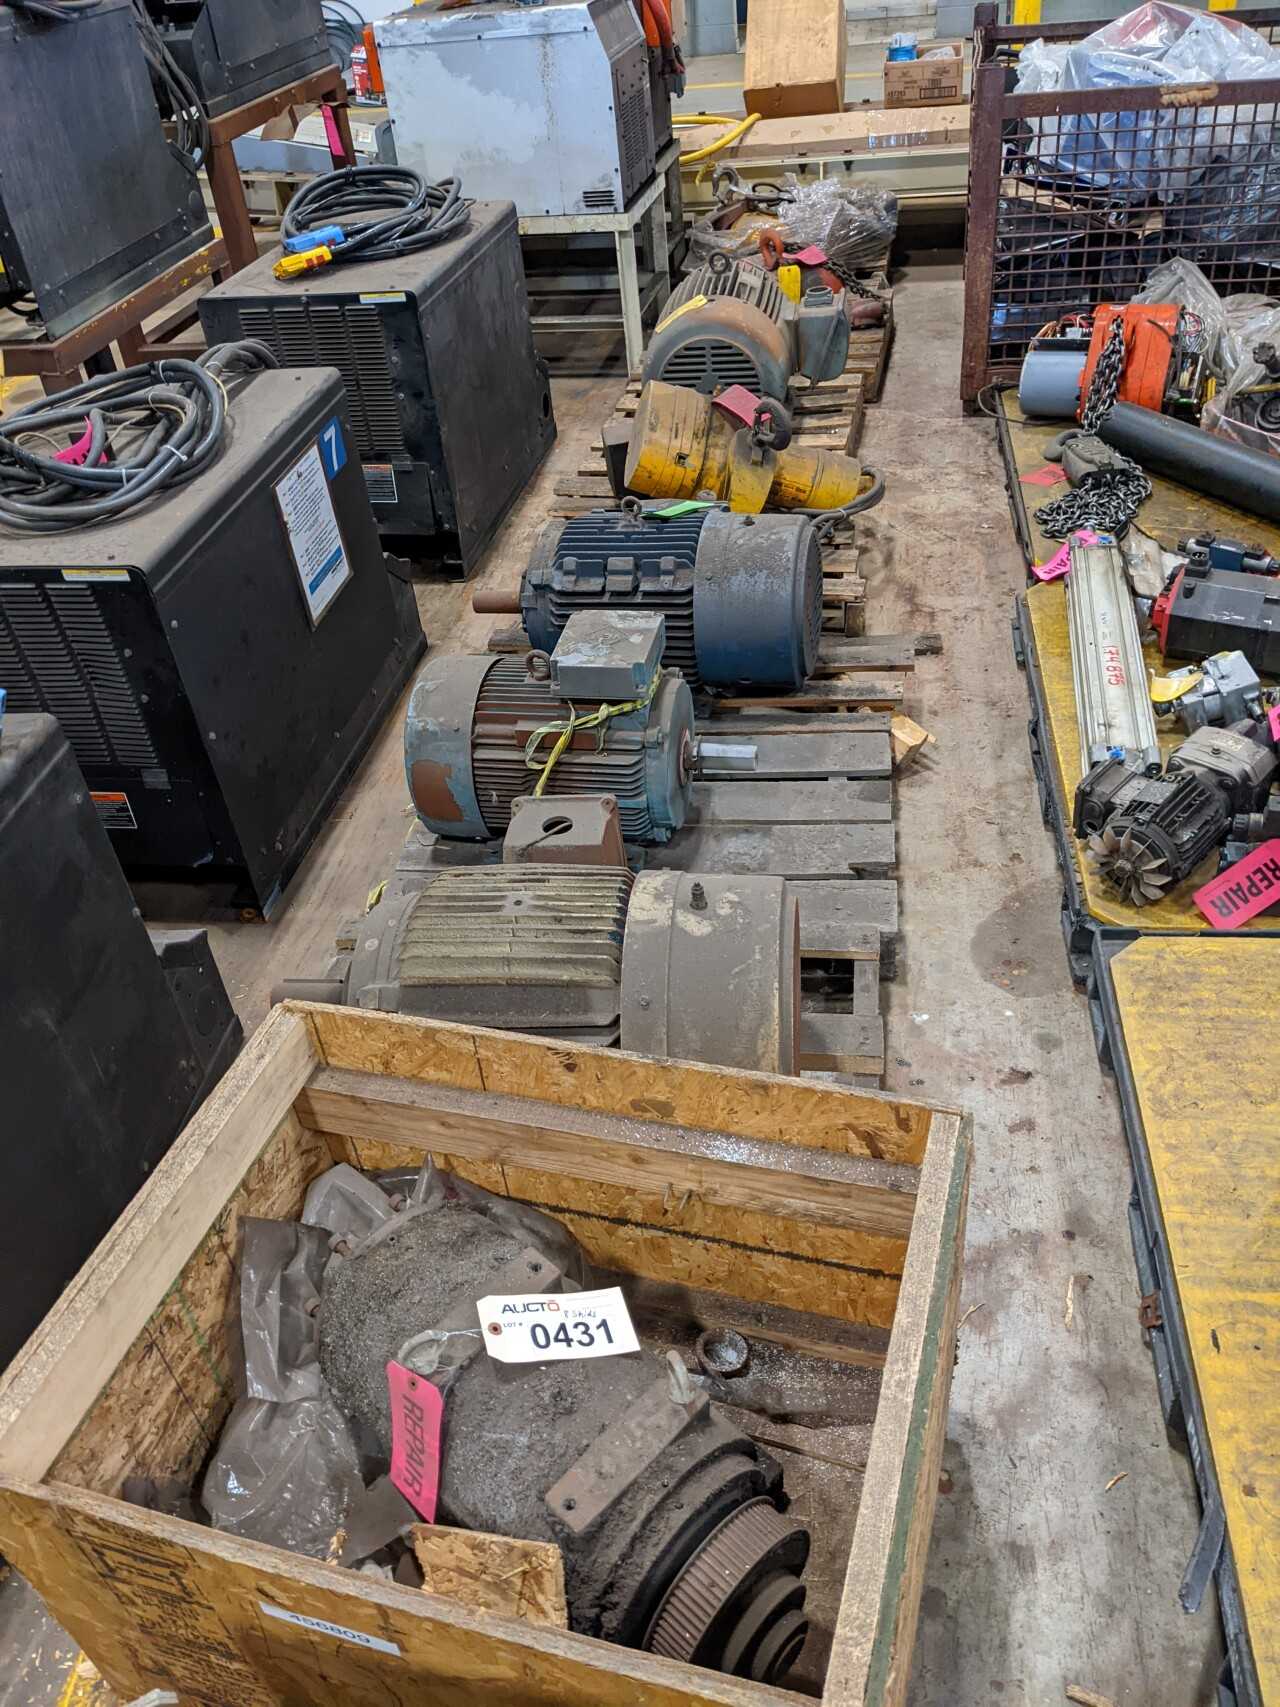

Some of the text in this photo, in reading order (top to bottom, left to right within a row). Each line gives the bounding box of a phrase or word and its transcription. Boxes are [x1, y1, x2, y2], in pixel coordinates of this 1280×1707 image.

[323, 423, 339, 475] 7
[1209, 857, 1280, 918] REPAIR
[530, 1318, 615, 1350] 0431
[402, 1393, 425, 1499] REPAIR
